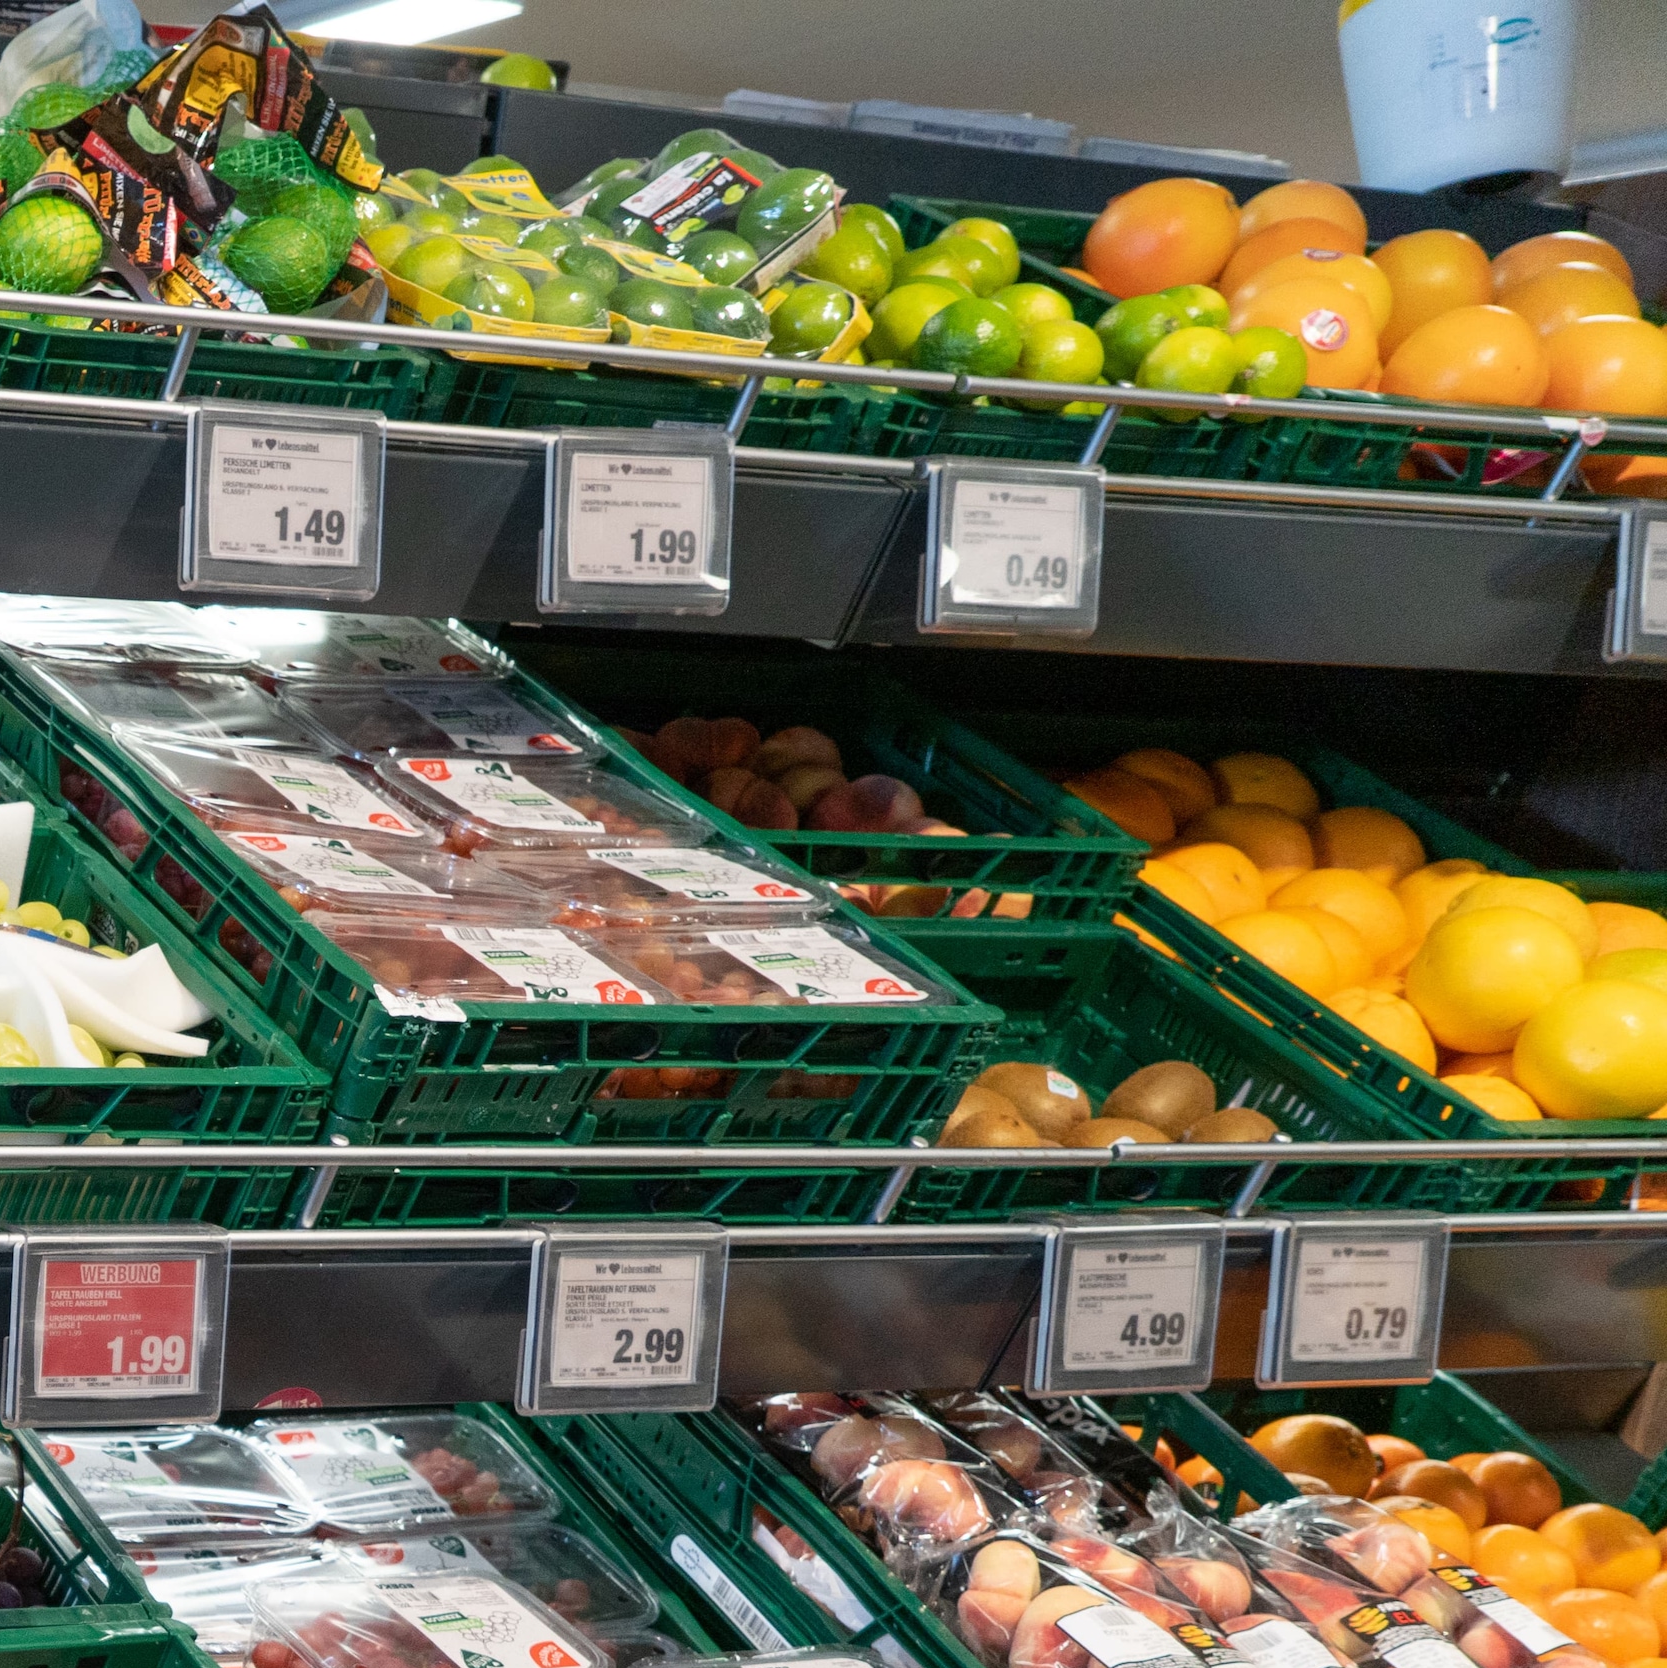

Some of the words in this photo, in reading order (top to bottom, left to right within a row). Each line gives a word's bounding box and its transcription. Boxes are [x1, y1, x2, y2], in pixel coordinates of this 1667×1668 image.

[275, 507, 345, 545] 1.49
[631, 528, 696, 564] 1.99
[1006, 554, 1068, 589] 0.49
[80, 1262, 161, 1285] WERBUNG
[51, 1290, 104, 1300] TAFELTRAUBEN
[105, 1290, 123, 1300] HELL
[50, 1314, 111, 1323] URSPRUNGSLAND
[1120, 1313, 1185, 1347] 4.99
[1345, 1307, 1407, 1340] 0.79
[107, 1336, 185, 1375] 1.99
[613, 1329, 684, 1364] 2.99
